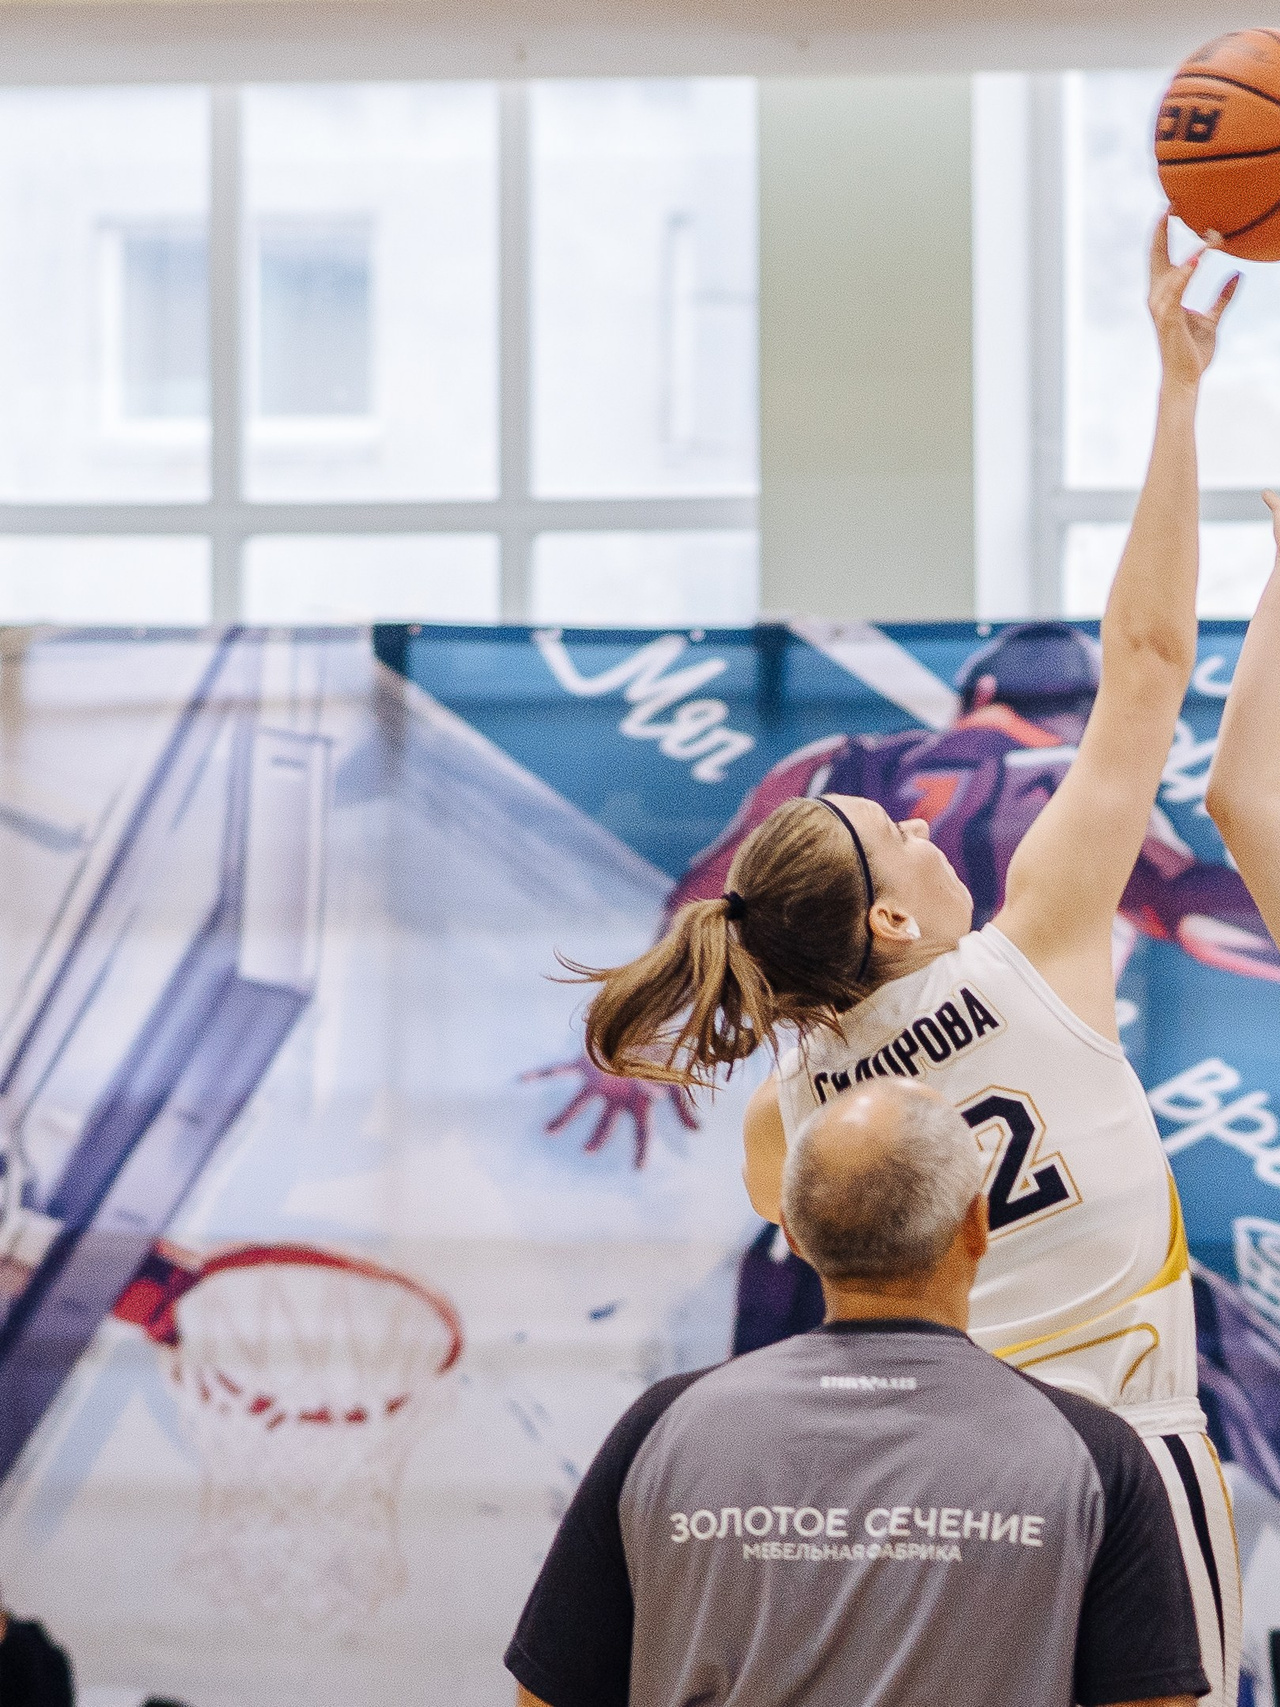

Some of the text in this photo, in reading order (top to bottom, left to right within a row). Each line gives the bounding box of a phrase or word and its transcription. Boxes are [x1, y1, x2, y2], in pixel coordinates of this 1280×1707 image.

[669, 1504, 1046, 1548] ЗОЛОТОЕ СЕЧЕНИЕ
[741, 1542, 864, 1561] МЕБЕЛЬНАЯ
